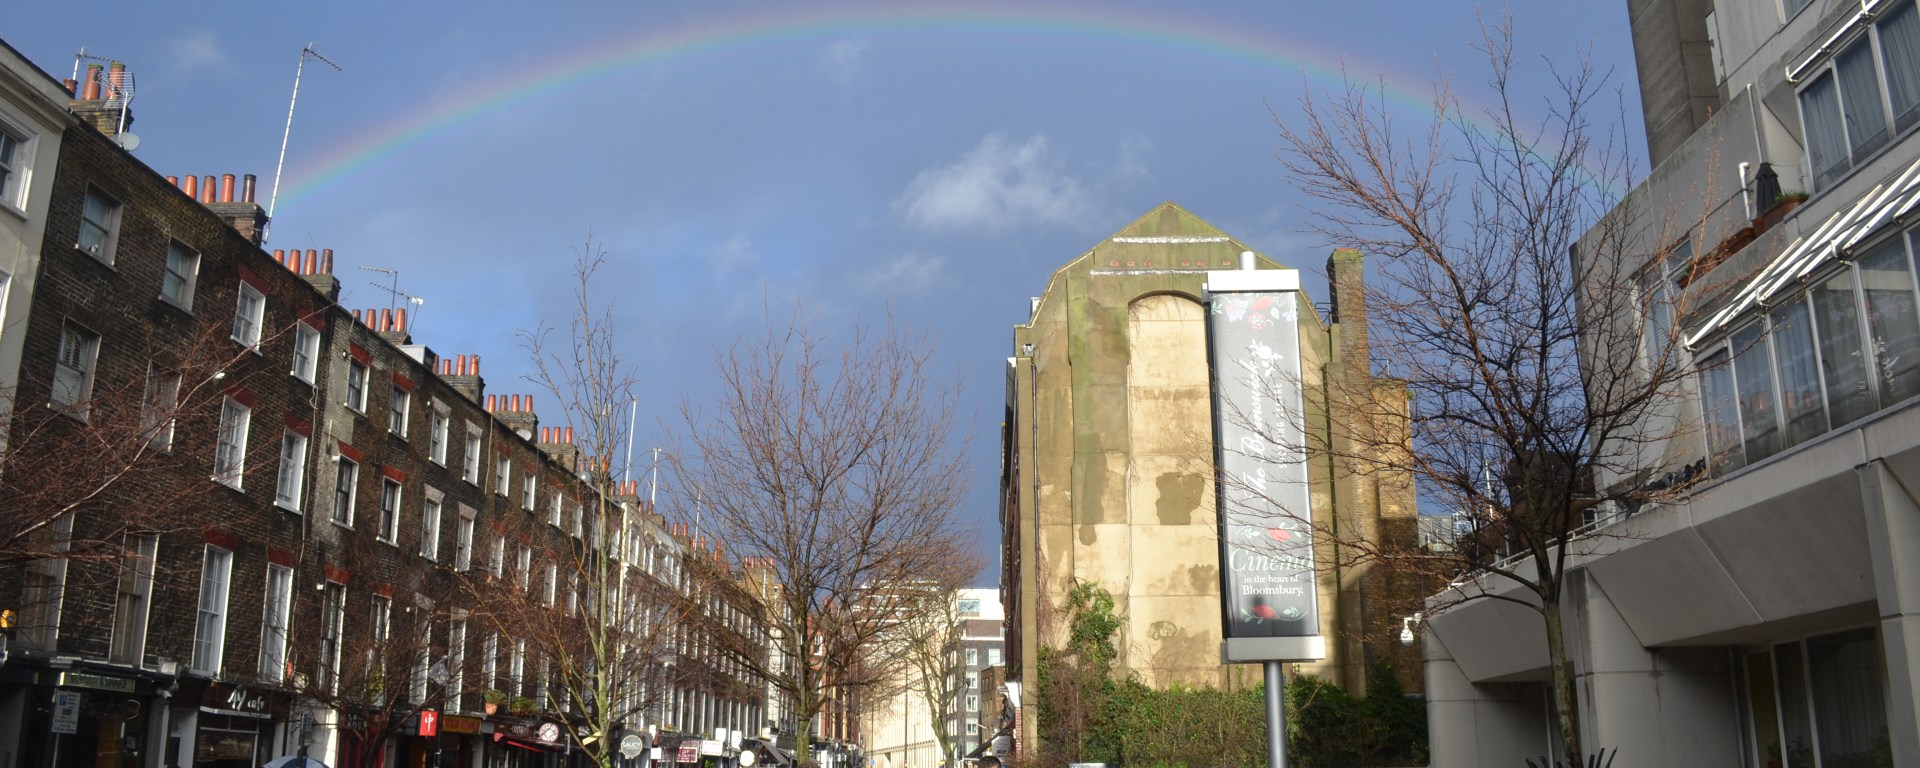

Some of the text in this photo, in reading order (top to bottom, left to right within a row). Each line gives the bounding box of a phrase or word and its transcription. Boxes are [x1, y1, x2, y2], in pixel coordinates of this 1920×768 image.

[1242, 467, 1268, 502] The
[1229, 548, 1314, 572] Cinema
[1243, 574, 1299, 583] in the heart of
[1242, 585, 1304, 597] Bloomsbury.
